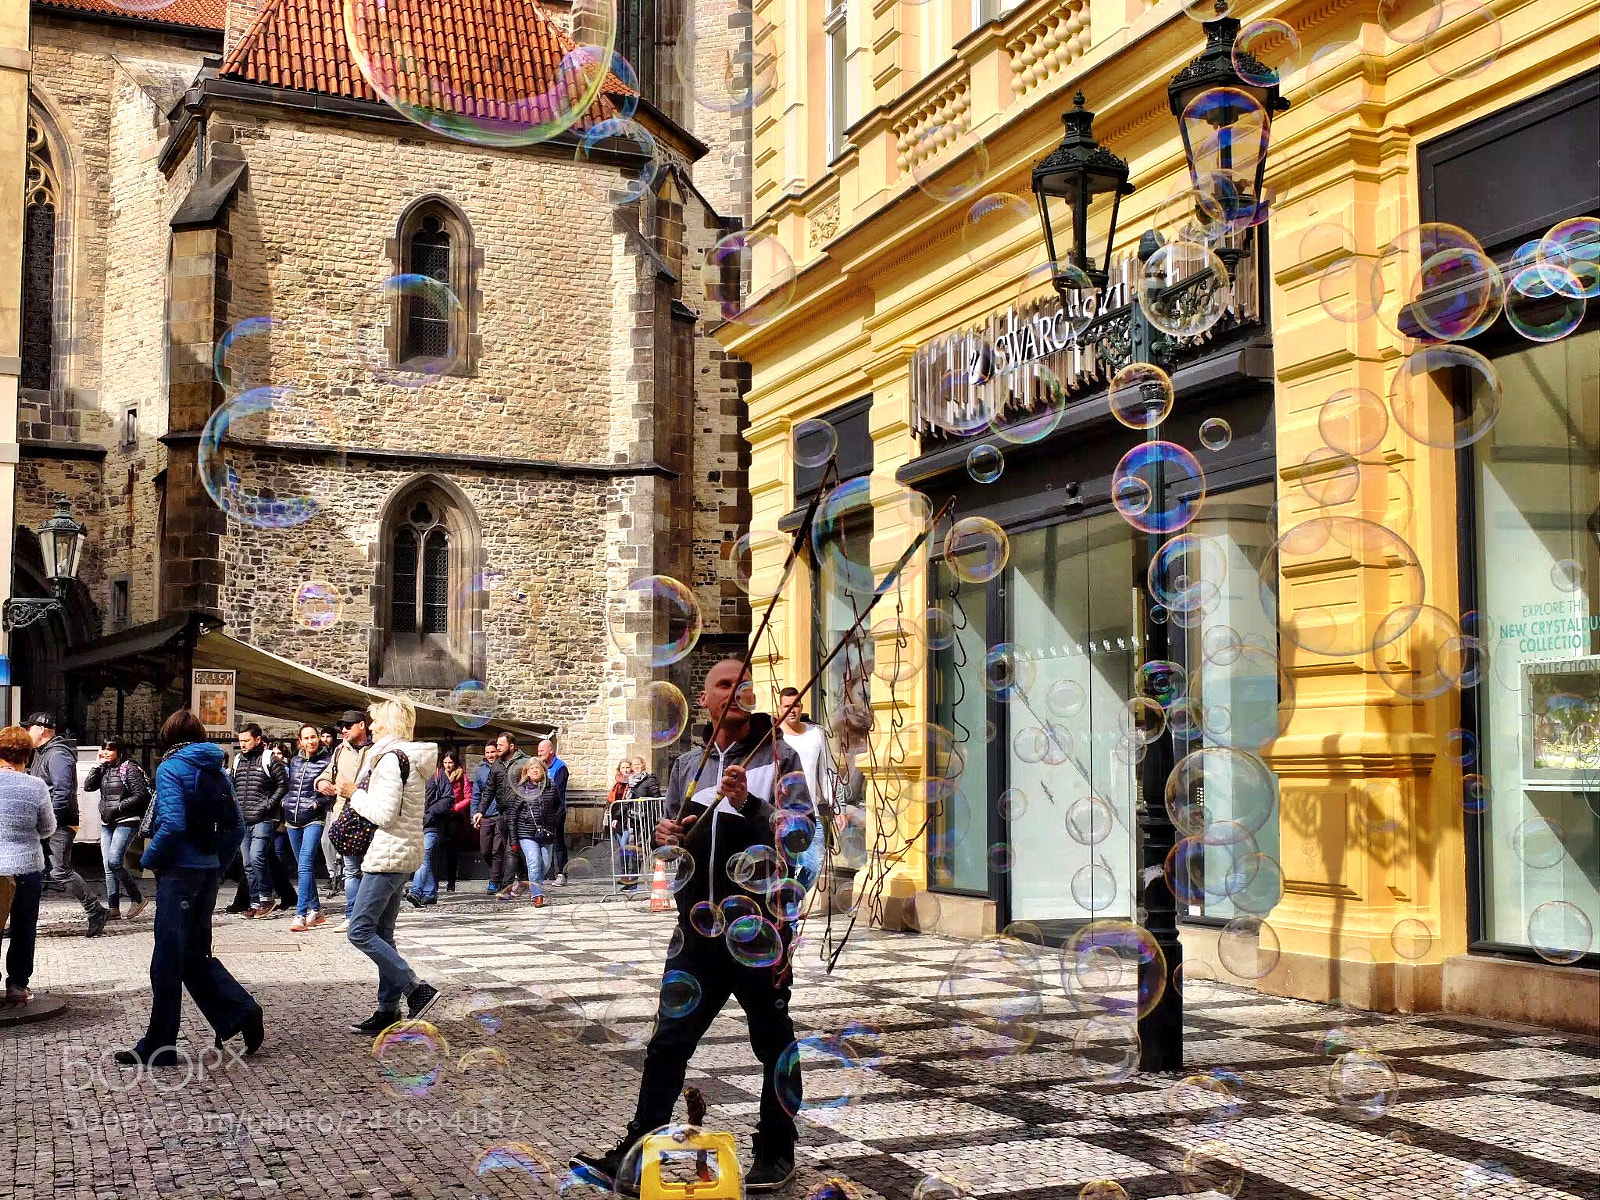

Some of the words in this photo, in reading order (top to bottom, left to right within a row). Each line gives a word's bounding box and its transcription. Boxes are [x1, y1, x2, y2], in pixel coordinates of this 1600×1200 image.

[1522, 602, 1565, 617] EXPLORE
[1568, 599, 1588, 613] THE
[1500, 624, 1527, 639] NEW
[1530, 615, 1600, 636] CRYSTALDU
[1519, 635, 1591, 652] COLLECTION
